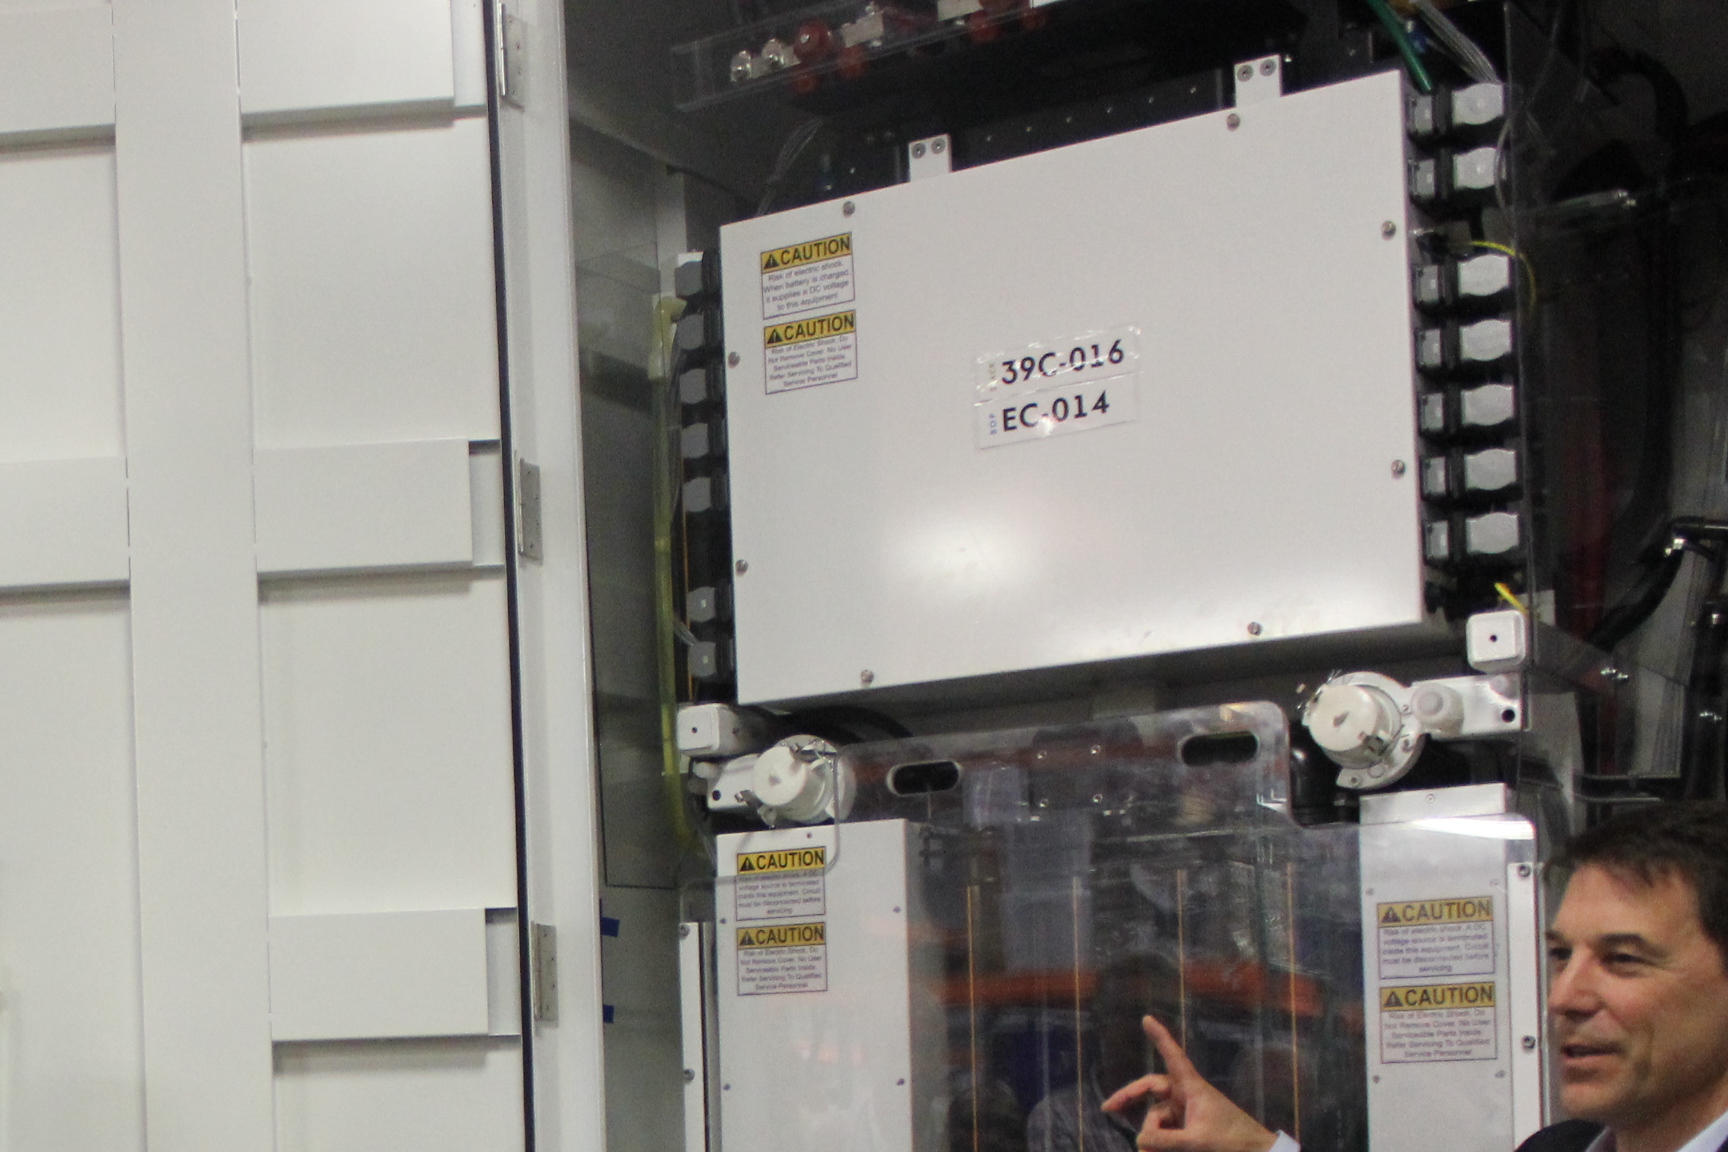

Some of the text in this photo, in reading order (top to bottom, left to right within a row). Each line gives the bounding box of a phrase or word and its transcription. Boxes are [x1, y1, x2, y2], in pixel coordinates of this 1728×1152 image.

[780, 236, 850, 265] CAUTION
[784, 314, 854, 340] CAUTION
[1002, 340, 1124, 384] 39C-016
[1003, 390, 1110, 432] EC-014
[756, 850, 824, 870] CAUTION
[1402, 900, 1490, 921] CAUTION
[756, 926, 824, 944] CAUTION
[1404, 985, 1492, 1006] CAUTION
